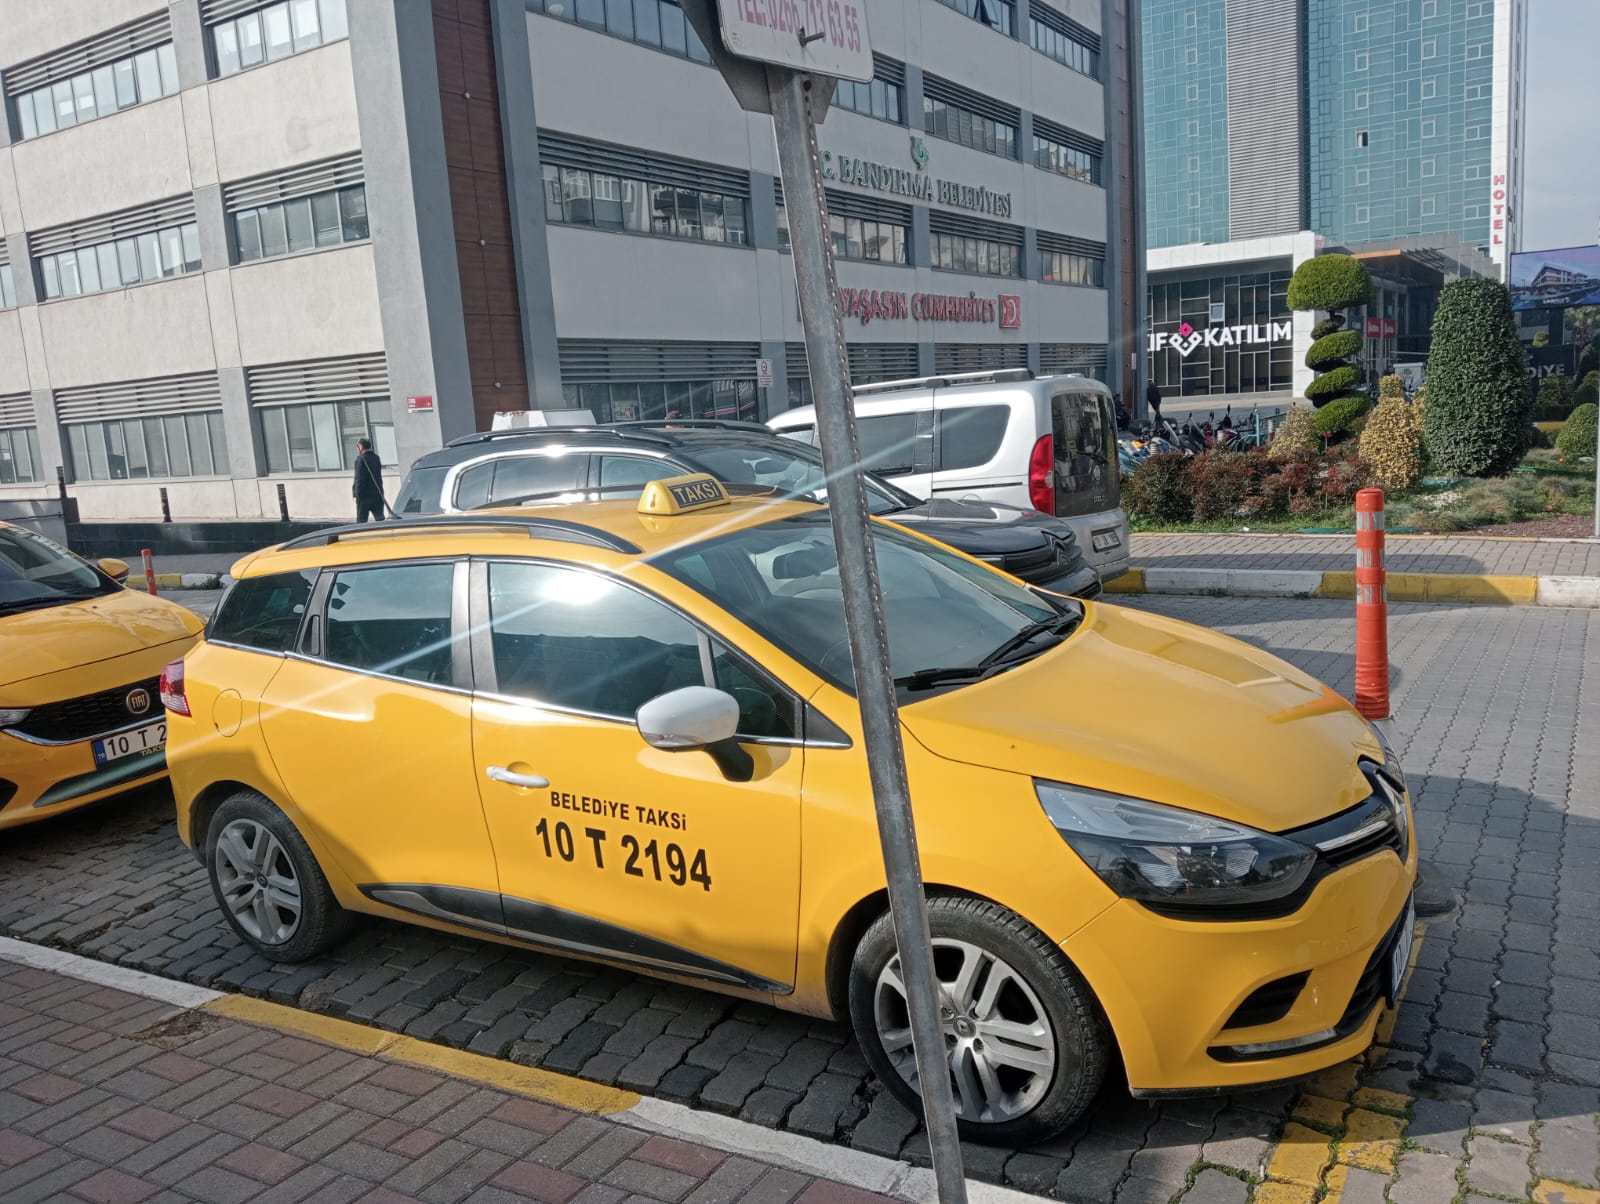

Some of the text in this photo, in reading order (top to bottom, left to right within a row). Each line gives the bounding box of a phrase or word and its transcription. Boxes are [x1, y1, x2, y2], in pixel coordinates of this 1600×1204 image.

[827, 0, 844, 48] 63
[844, 4, 860, 53] 55
[838, 154, 934, 202] BANDIRMA
[936, 178, 1012, 219] BELEDİYESİ
[1493, 174, 1505, 245] HOTEL
[1204, 321, 1292, 348] KATILIM
[131, 694, 146, 710] FIAT
[107, 736, 130, 757] 10
[137, 729, 148, 748] T
[535, 817, 712, 892] 10 T 2194
